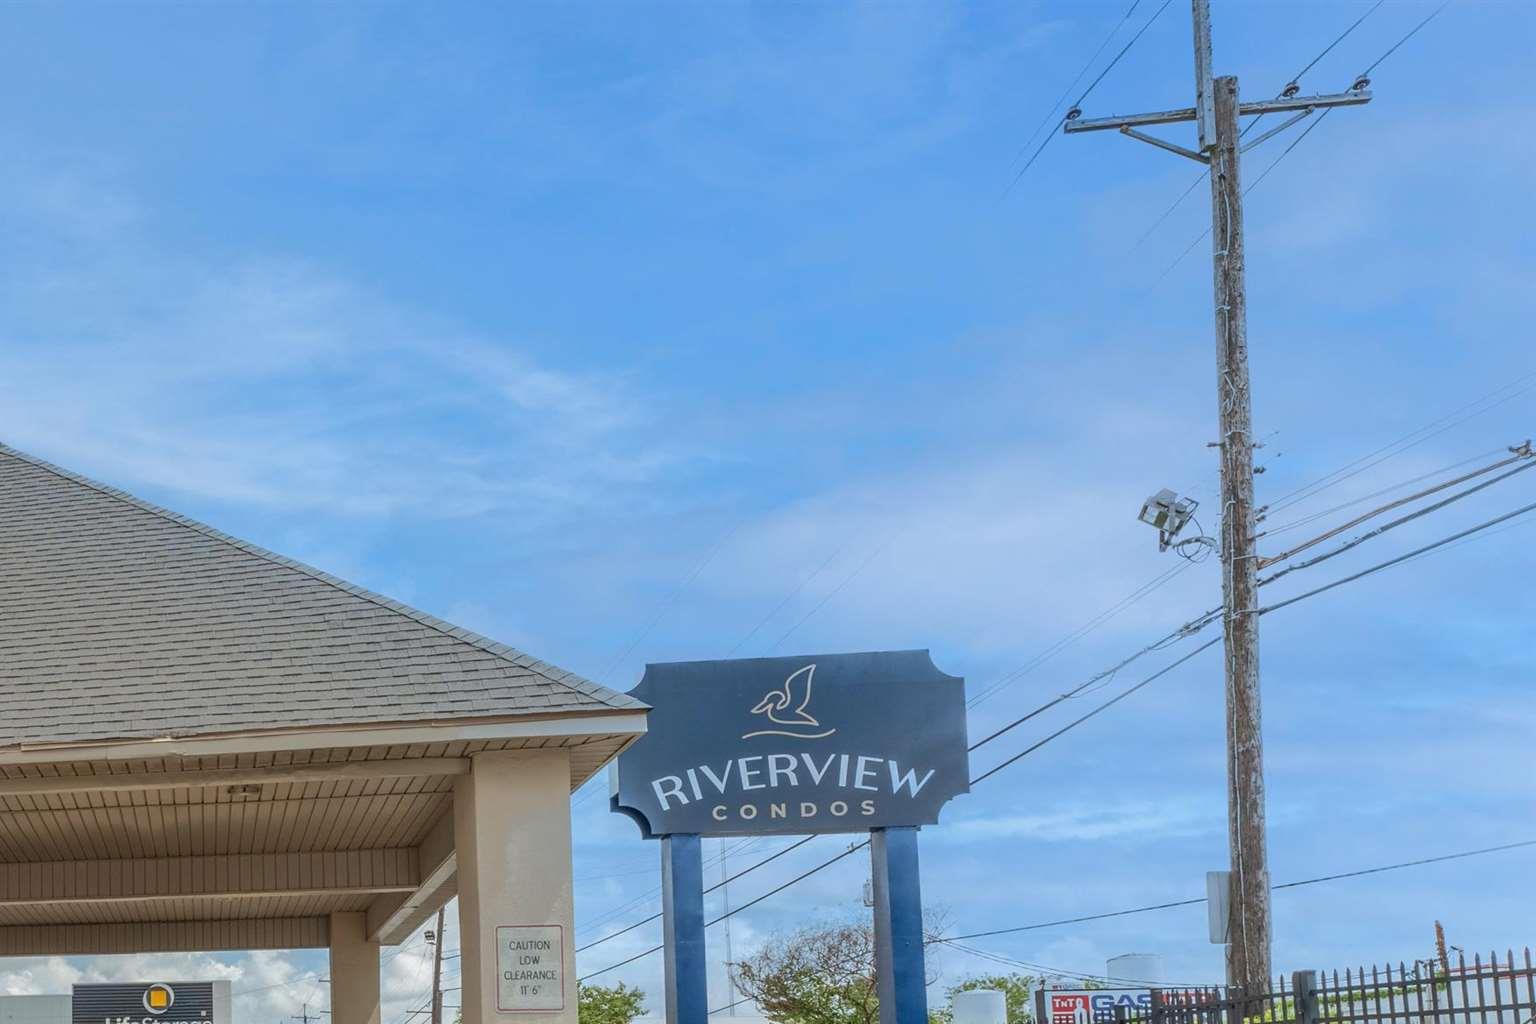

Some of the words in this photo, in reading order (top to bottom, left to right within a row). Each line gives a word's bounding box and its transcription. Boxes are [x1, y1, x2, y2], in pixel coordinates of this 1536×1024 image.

[651, 752, 936, 811] RIVERVIEW
[711, 800, 876, 820] CONDOS
[508, 940, 551, 950] CAUTION
[519, 955, 540, 966] LOW
[504, 970, 558, 980] CLEARANCE
